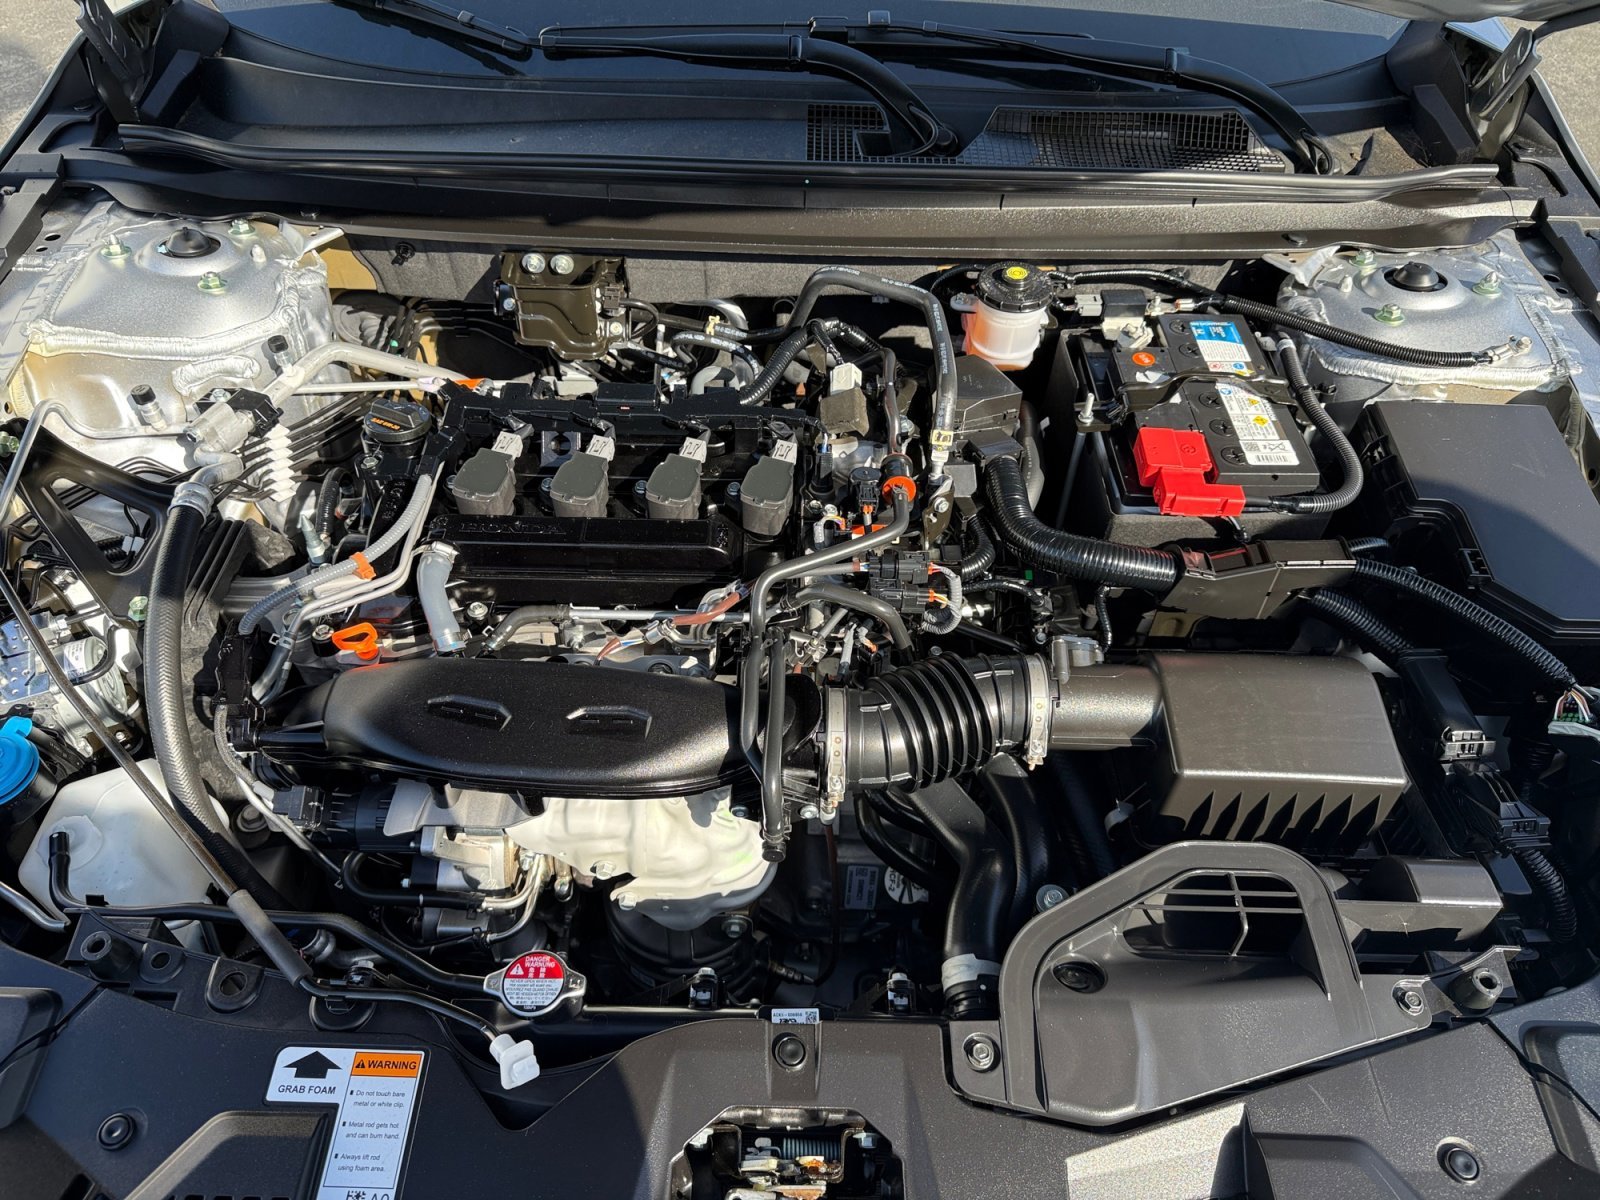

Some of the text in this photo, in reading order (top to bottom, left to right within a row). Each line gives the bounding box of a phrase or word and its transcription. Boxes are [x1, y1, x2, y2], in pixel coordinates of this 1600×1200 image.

[367, 1060, 417, 1070] WARNING
[278, 1085, 336, 1095] GRAB FOAM
[376, 1122, 389, 1130] gets
[340, 1153, 361, 1161] Always
[361, 1153, 370, 1161] lift
[337, 1164, 354, 1172] using
